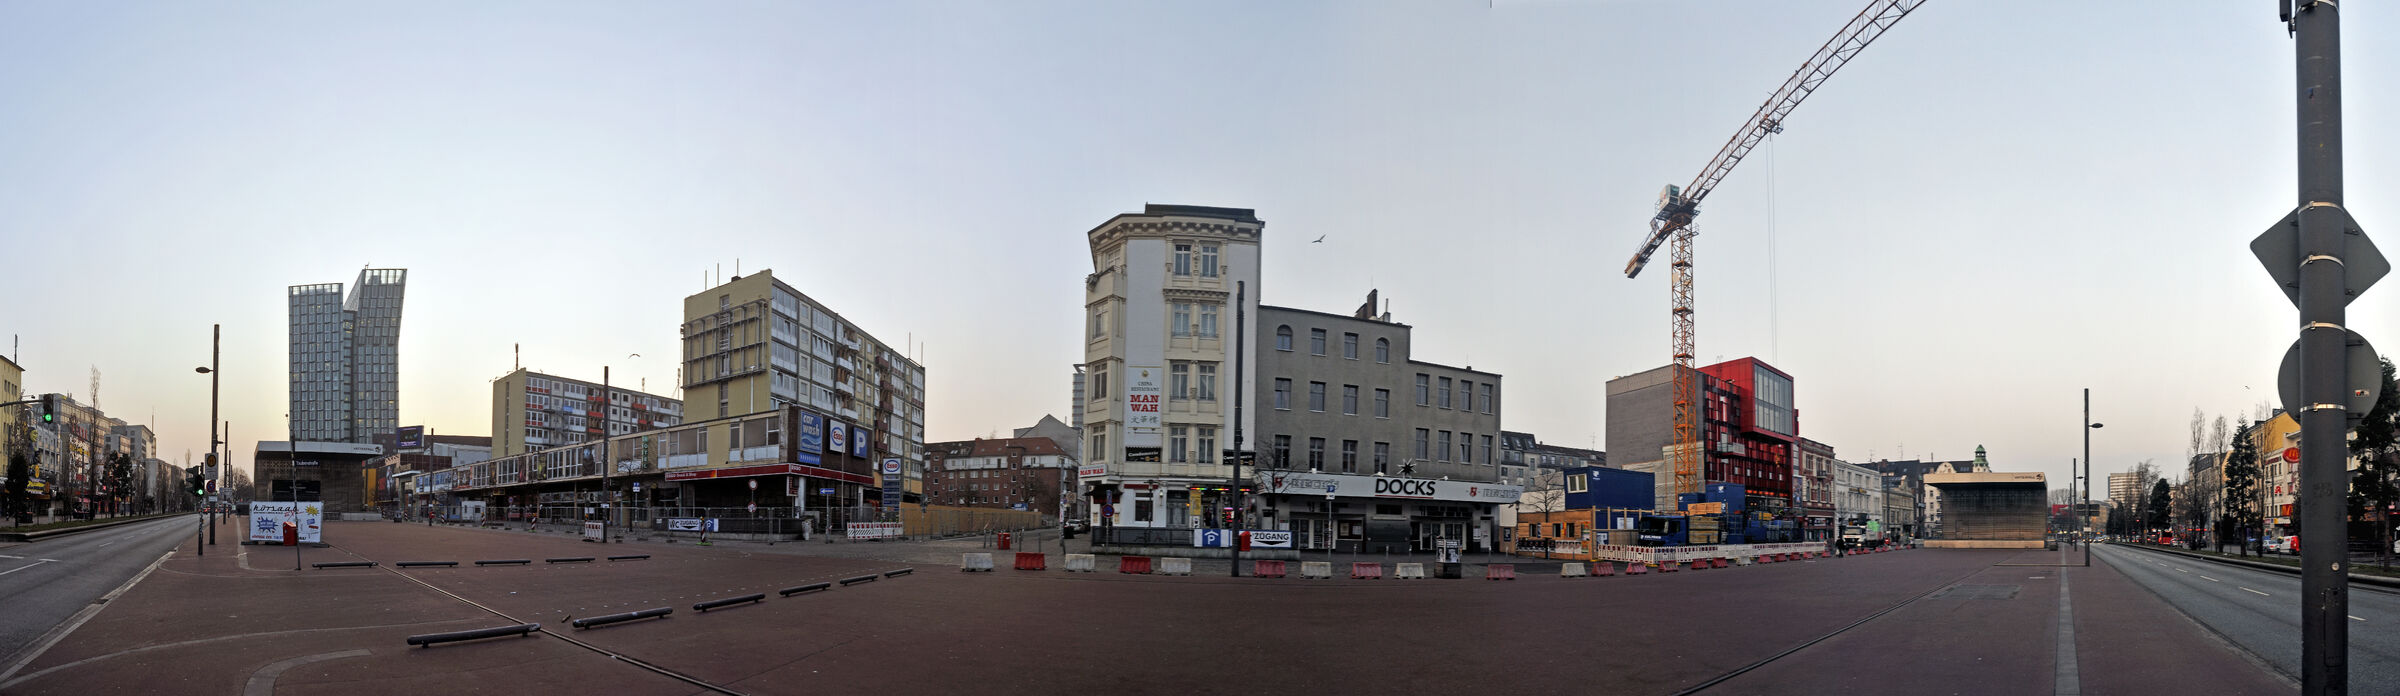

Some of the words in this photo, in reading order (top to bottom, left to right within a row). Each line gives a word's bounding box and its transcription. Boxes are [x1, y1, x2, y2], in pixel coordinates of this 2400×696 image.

[1130, 394, 1160, 403] MAN
[1130, 403, 1159, 413] WAH
[803, 414, 814, 423] car
[803, 424, 820, 436] wash
[833, 430, 843, 441] Esso
[856, 431, 866, 455] P
[1375, 479, 1436, 496] DOCKS
[1254, 533, 1290, 541] ZUGANG
